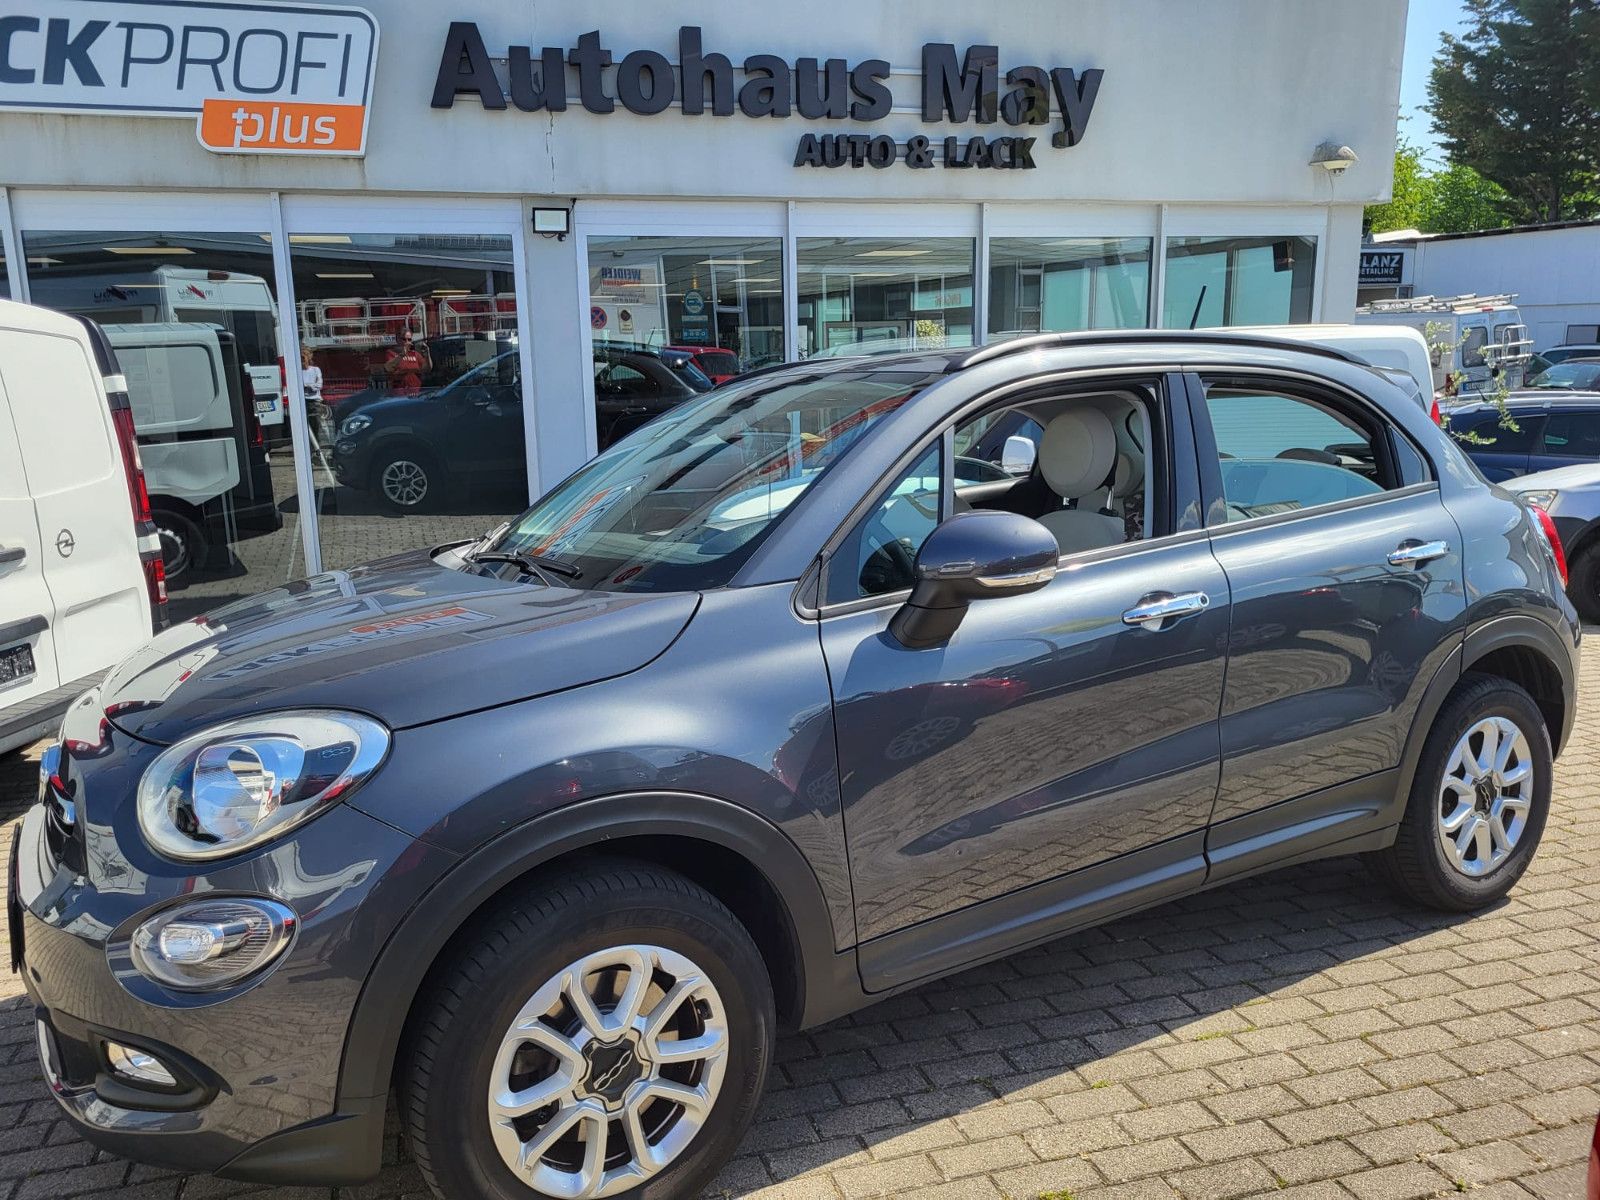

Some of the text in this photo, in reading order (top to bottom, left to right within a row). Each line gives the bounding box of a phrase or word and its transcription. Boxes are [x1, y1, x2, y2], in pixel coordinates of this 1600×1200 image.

[431, 21, 1105, 148] Autohaus May
[232, 106, 336, 149] plus
[793, 132, 1037, 169] AUTO & LACK
